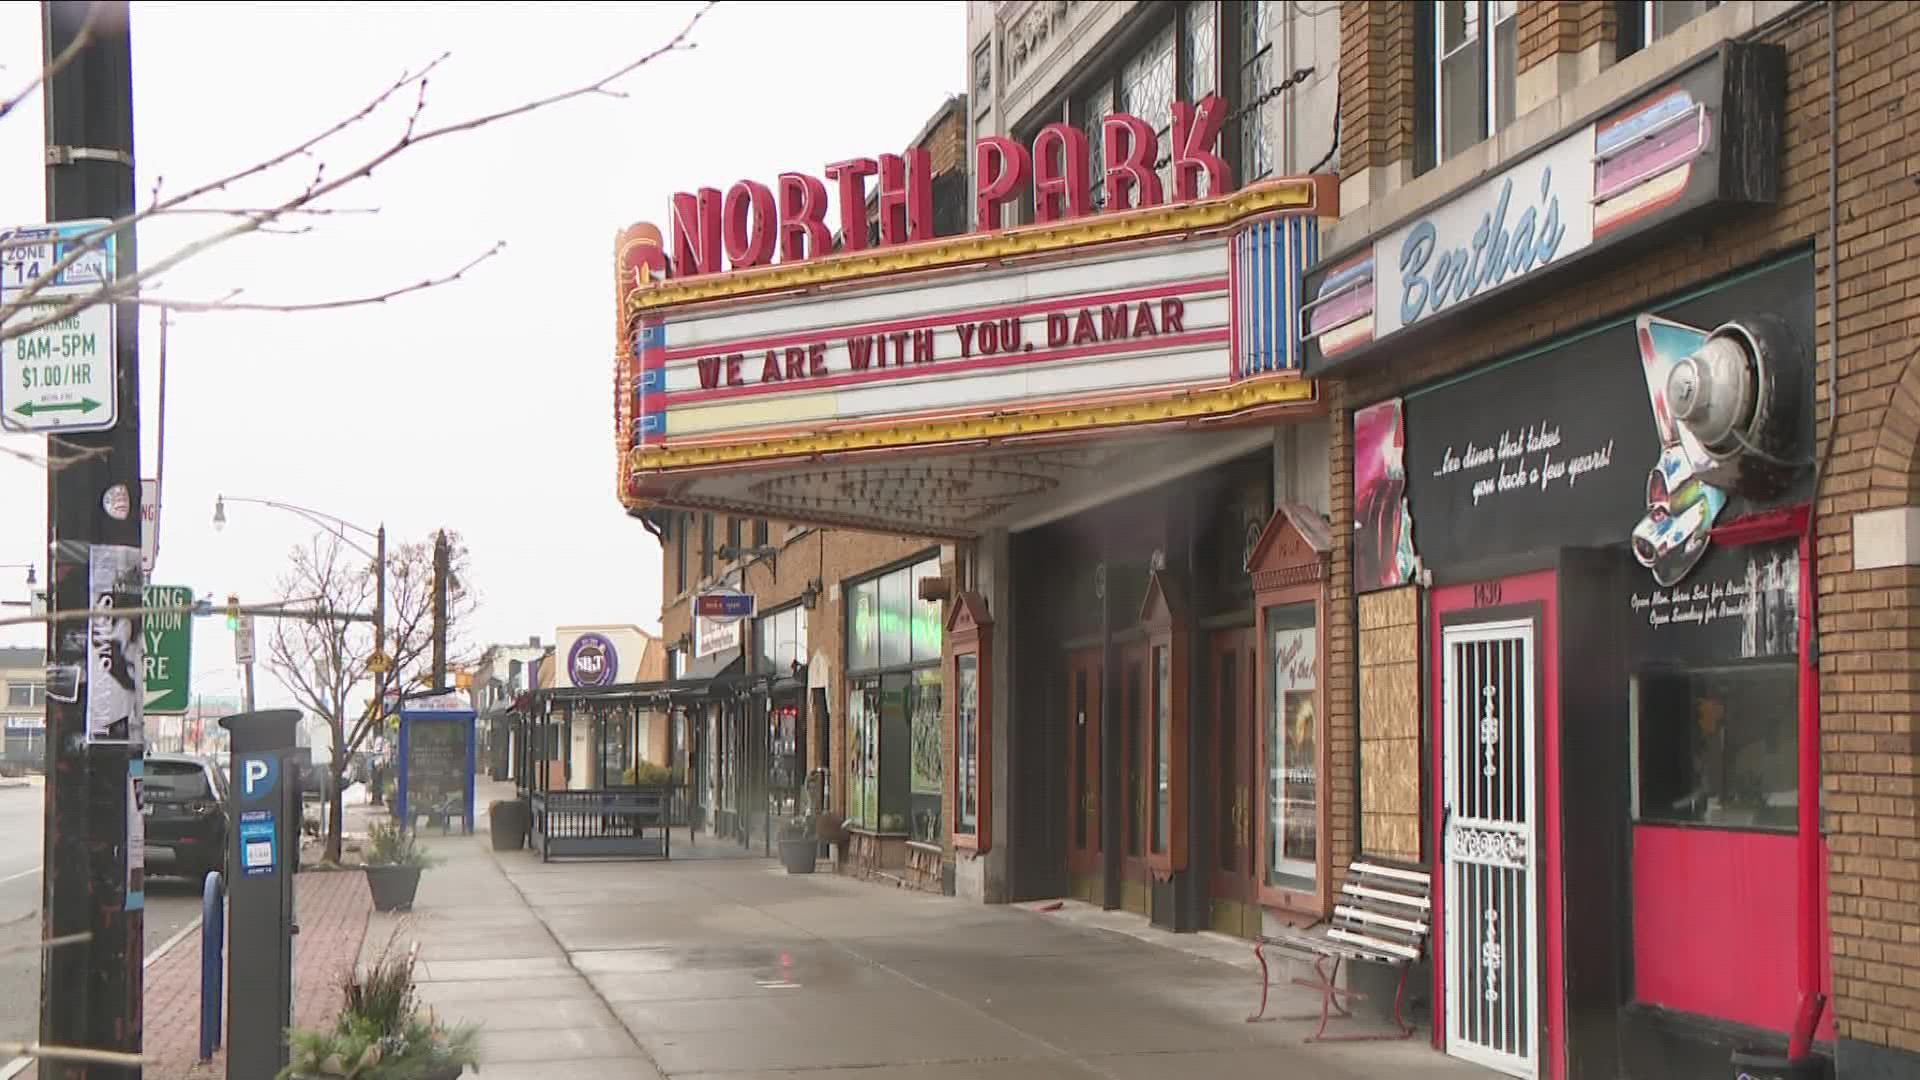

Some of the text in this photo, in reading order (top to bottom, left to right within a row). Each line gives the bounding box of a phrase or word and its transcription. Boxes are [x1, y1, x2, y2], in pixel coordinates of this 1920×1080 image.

[670, 96, 1235, 277] NORTH PARK
[8, 246, 46, 260] ZONE
[1399, 166, 1566, 324] Bertha's
[14, 262, 40, 284] 14
[697, 354, 743, 389] WE
[761, 342, 828, 383] ARE
[847, 326, 934, 371] WITH
[1047, 296, 1185, 348] DAMAR
[22, 364, 92, 390] $1.00/HR
[1462, 441, 1495, 469] diner
[1497, 428, 1525, 460] that
[1526, 420, 1560, 453] takes
[1472, 439, 1614, 506] you back a few years!
[143, 587, 184, 608] KING
[145, 610, 182, 630] ATION
[143, 656, 170, 680] RE
[245, 759, 268, 794] P
